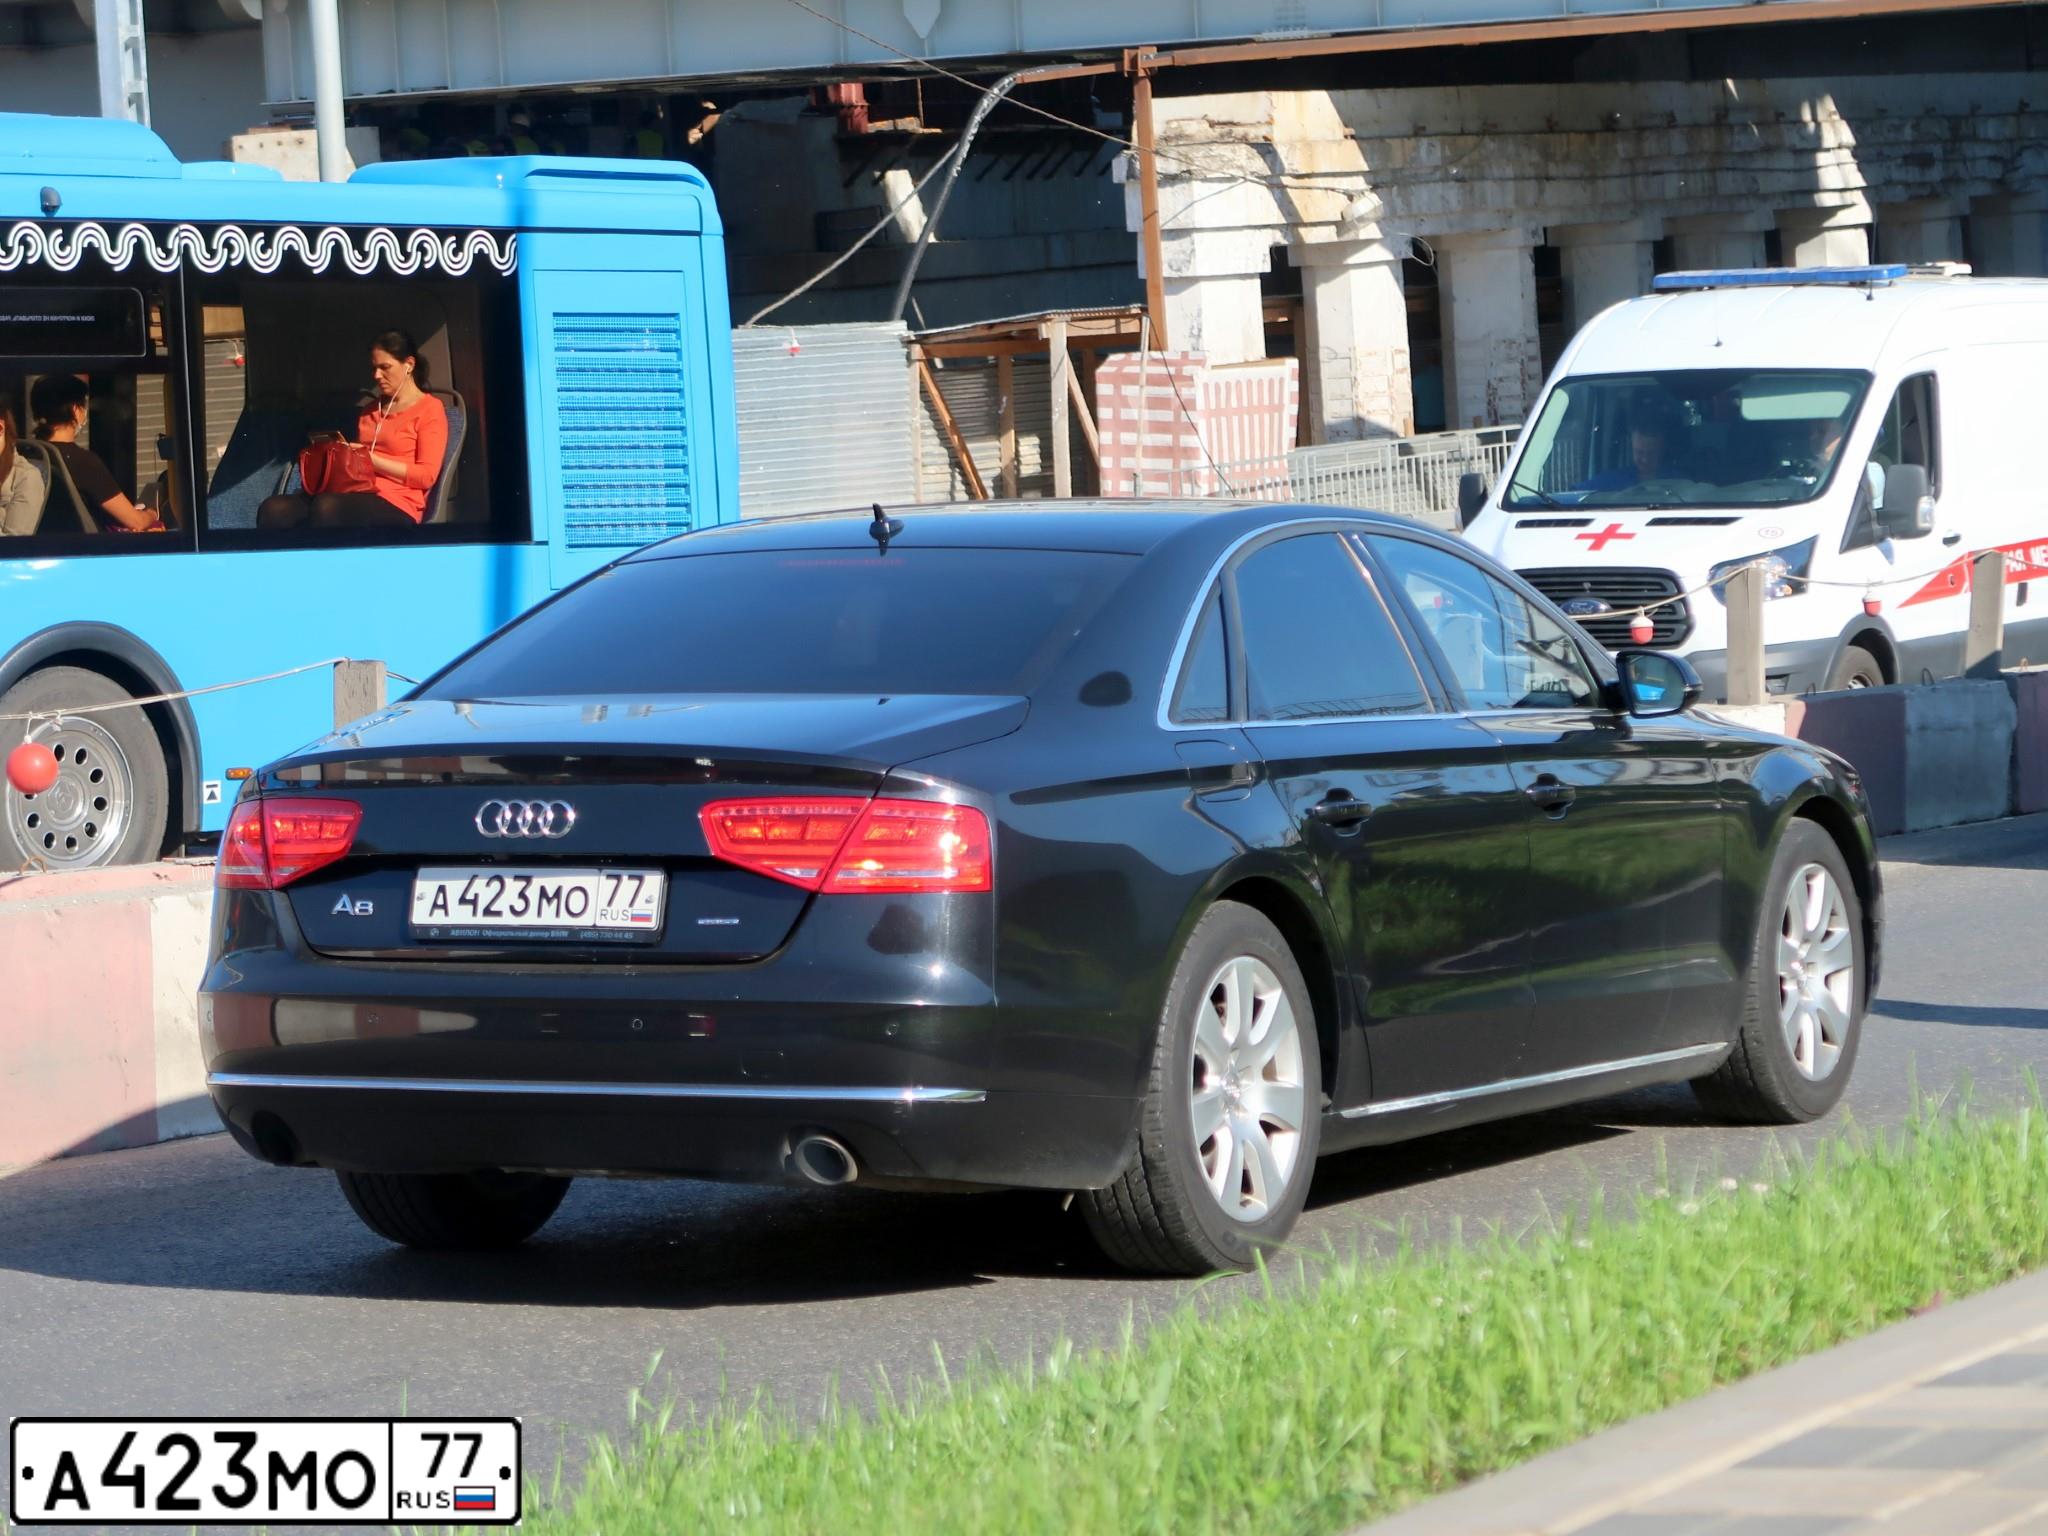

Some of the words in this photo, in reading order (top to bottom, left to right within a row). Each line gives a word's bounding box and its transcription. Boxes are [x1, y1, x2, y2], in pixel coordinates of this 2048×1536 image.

[604, 874, 646, 909] 77
[331, 893, 374, 916] A8
[599, 908, 629, 922] RUS
